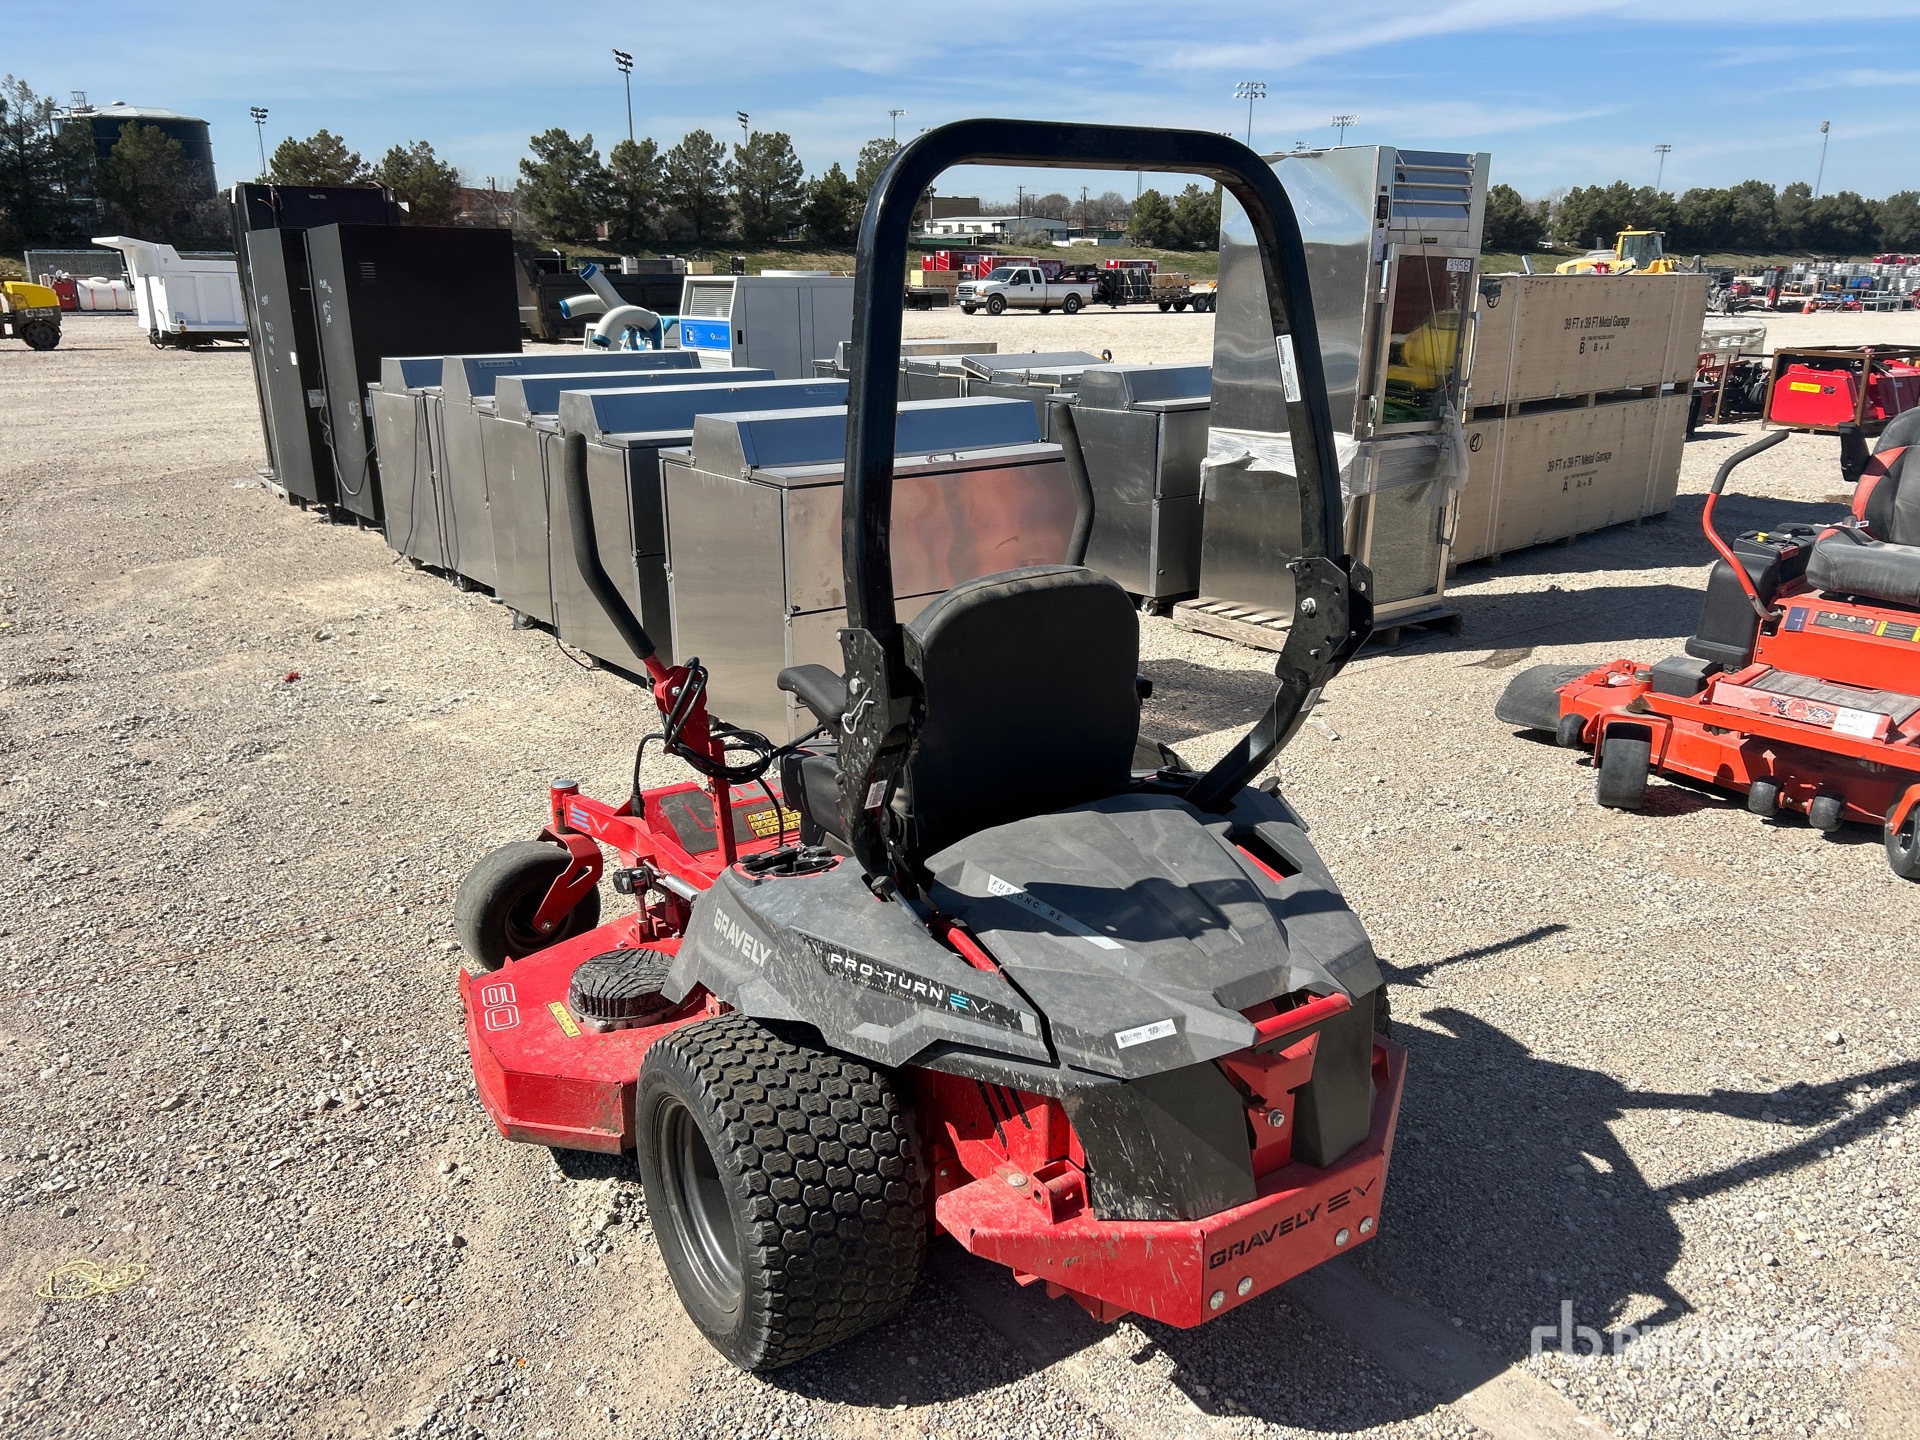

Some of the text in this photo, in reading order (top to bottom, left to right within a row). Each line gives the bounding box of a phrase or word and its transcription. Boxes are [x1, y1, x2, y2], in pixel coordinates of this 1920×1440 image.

[1448, 260, 1469, 271] 3458
[1564, 318, 1572, 330] 39
[1600, 315, 1613, 328] Metal
[1613, 315, 1630, 329] Garage
[1579, 342, 1585, 354] B
[1582, 453, 1595, 465] Metal
[1595, 451, 1612, 463] Garage
[1562, 481, 1568, 493] A
[991, 880, 1063, 921] FUSIONCORE
[713, 907, 772, 968] GRAVELY
[830, 953, 943, 1000] PRO-TURN
[482, 982, 520, 1031] 60
[1209, 1203, 1321, 1270] GRAVELY
